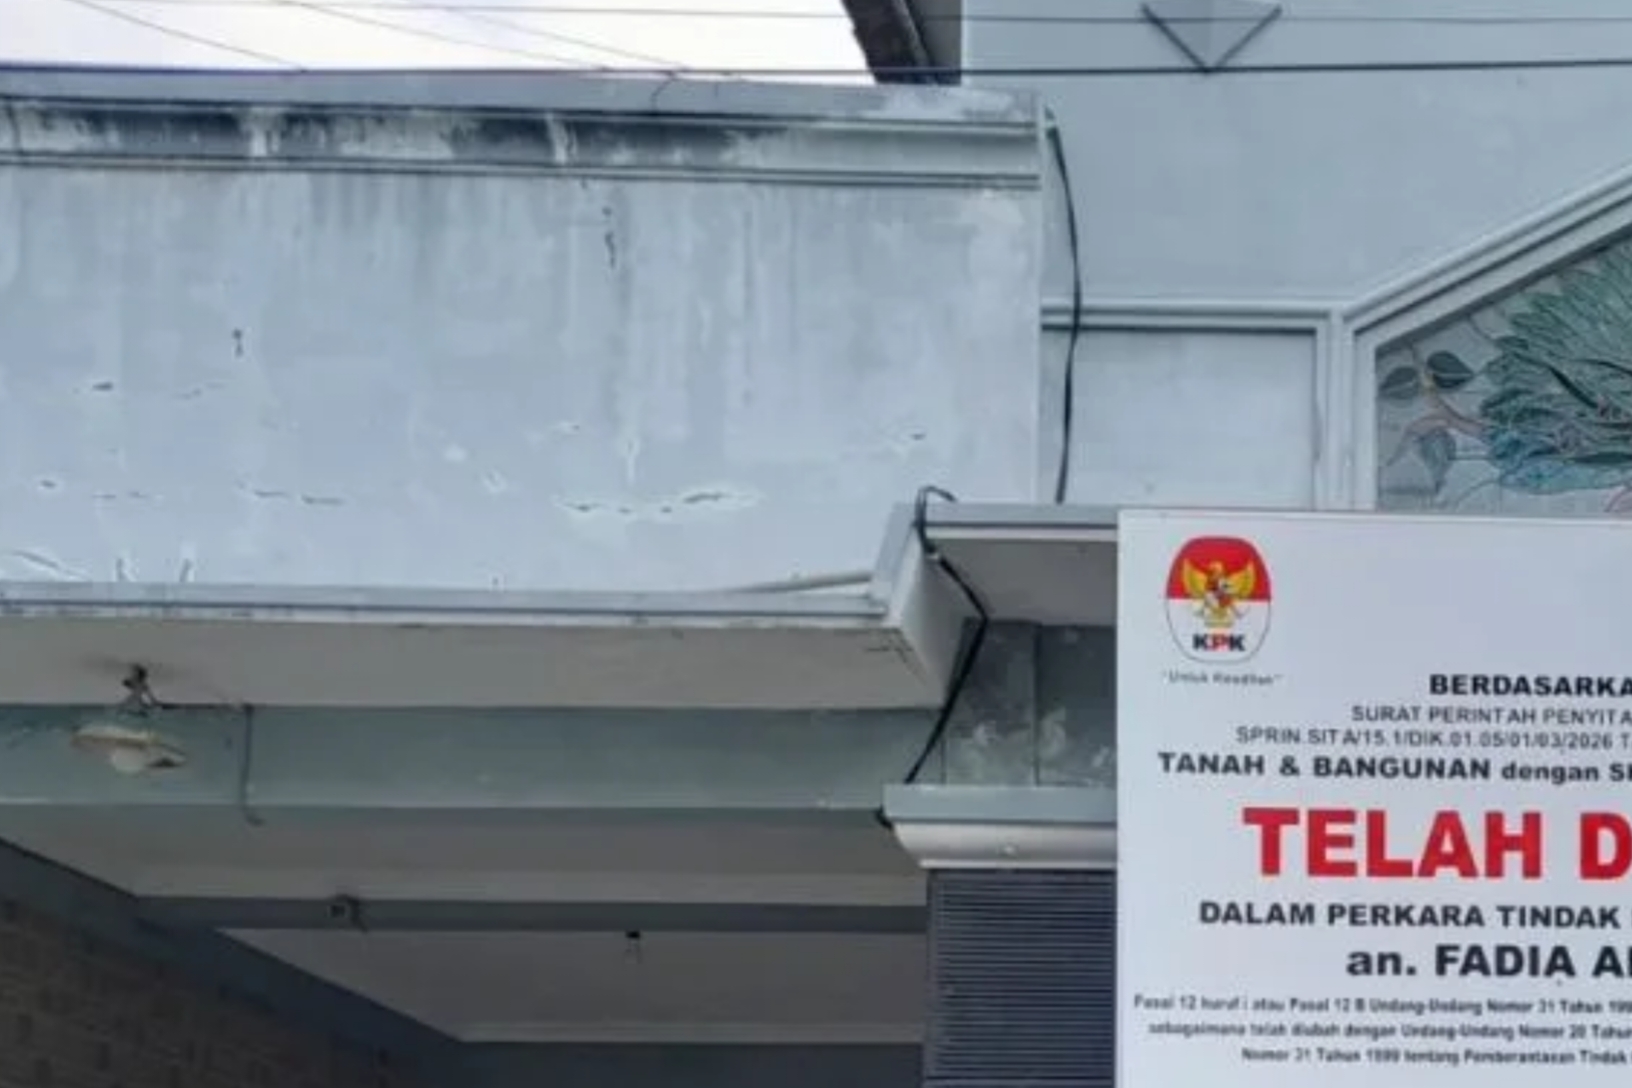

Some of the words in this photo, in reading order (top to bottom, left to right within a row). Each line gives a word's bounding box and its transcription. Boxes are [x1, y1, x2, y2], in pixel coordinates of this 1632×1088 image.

[1193, 634, 1247, 651] KPK
[1351, 704, 1422, 722] SURAT
[1428, 705, 1537, 725] PERINTAH
[1158, 752, 1265, 776] TANAH
[1279, 756, 1300, 776] &
[1313, 757, 1490, 780] BANGUNAN
[1501, 761, 1598, 785] dengan
[1242, 806, 1542, 880] TELAH
[1199, 900, 1316, 926] DALAM
[1327, 903, 1486, 928] PERKARA
[1496, 905, 1621, 930] TINDAK
[1347, 949, 1415, 977] an.
[1436, 945, 1575, 978] FADIA
